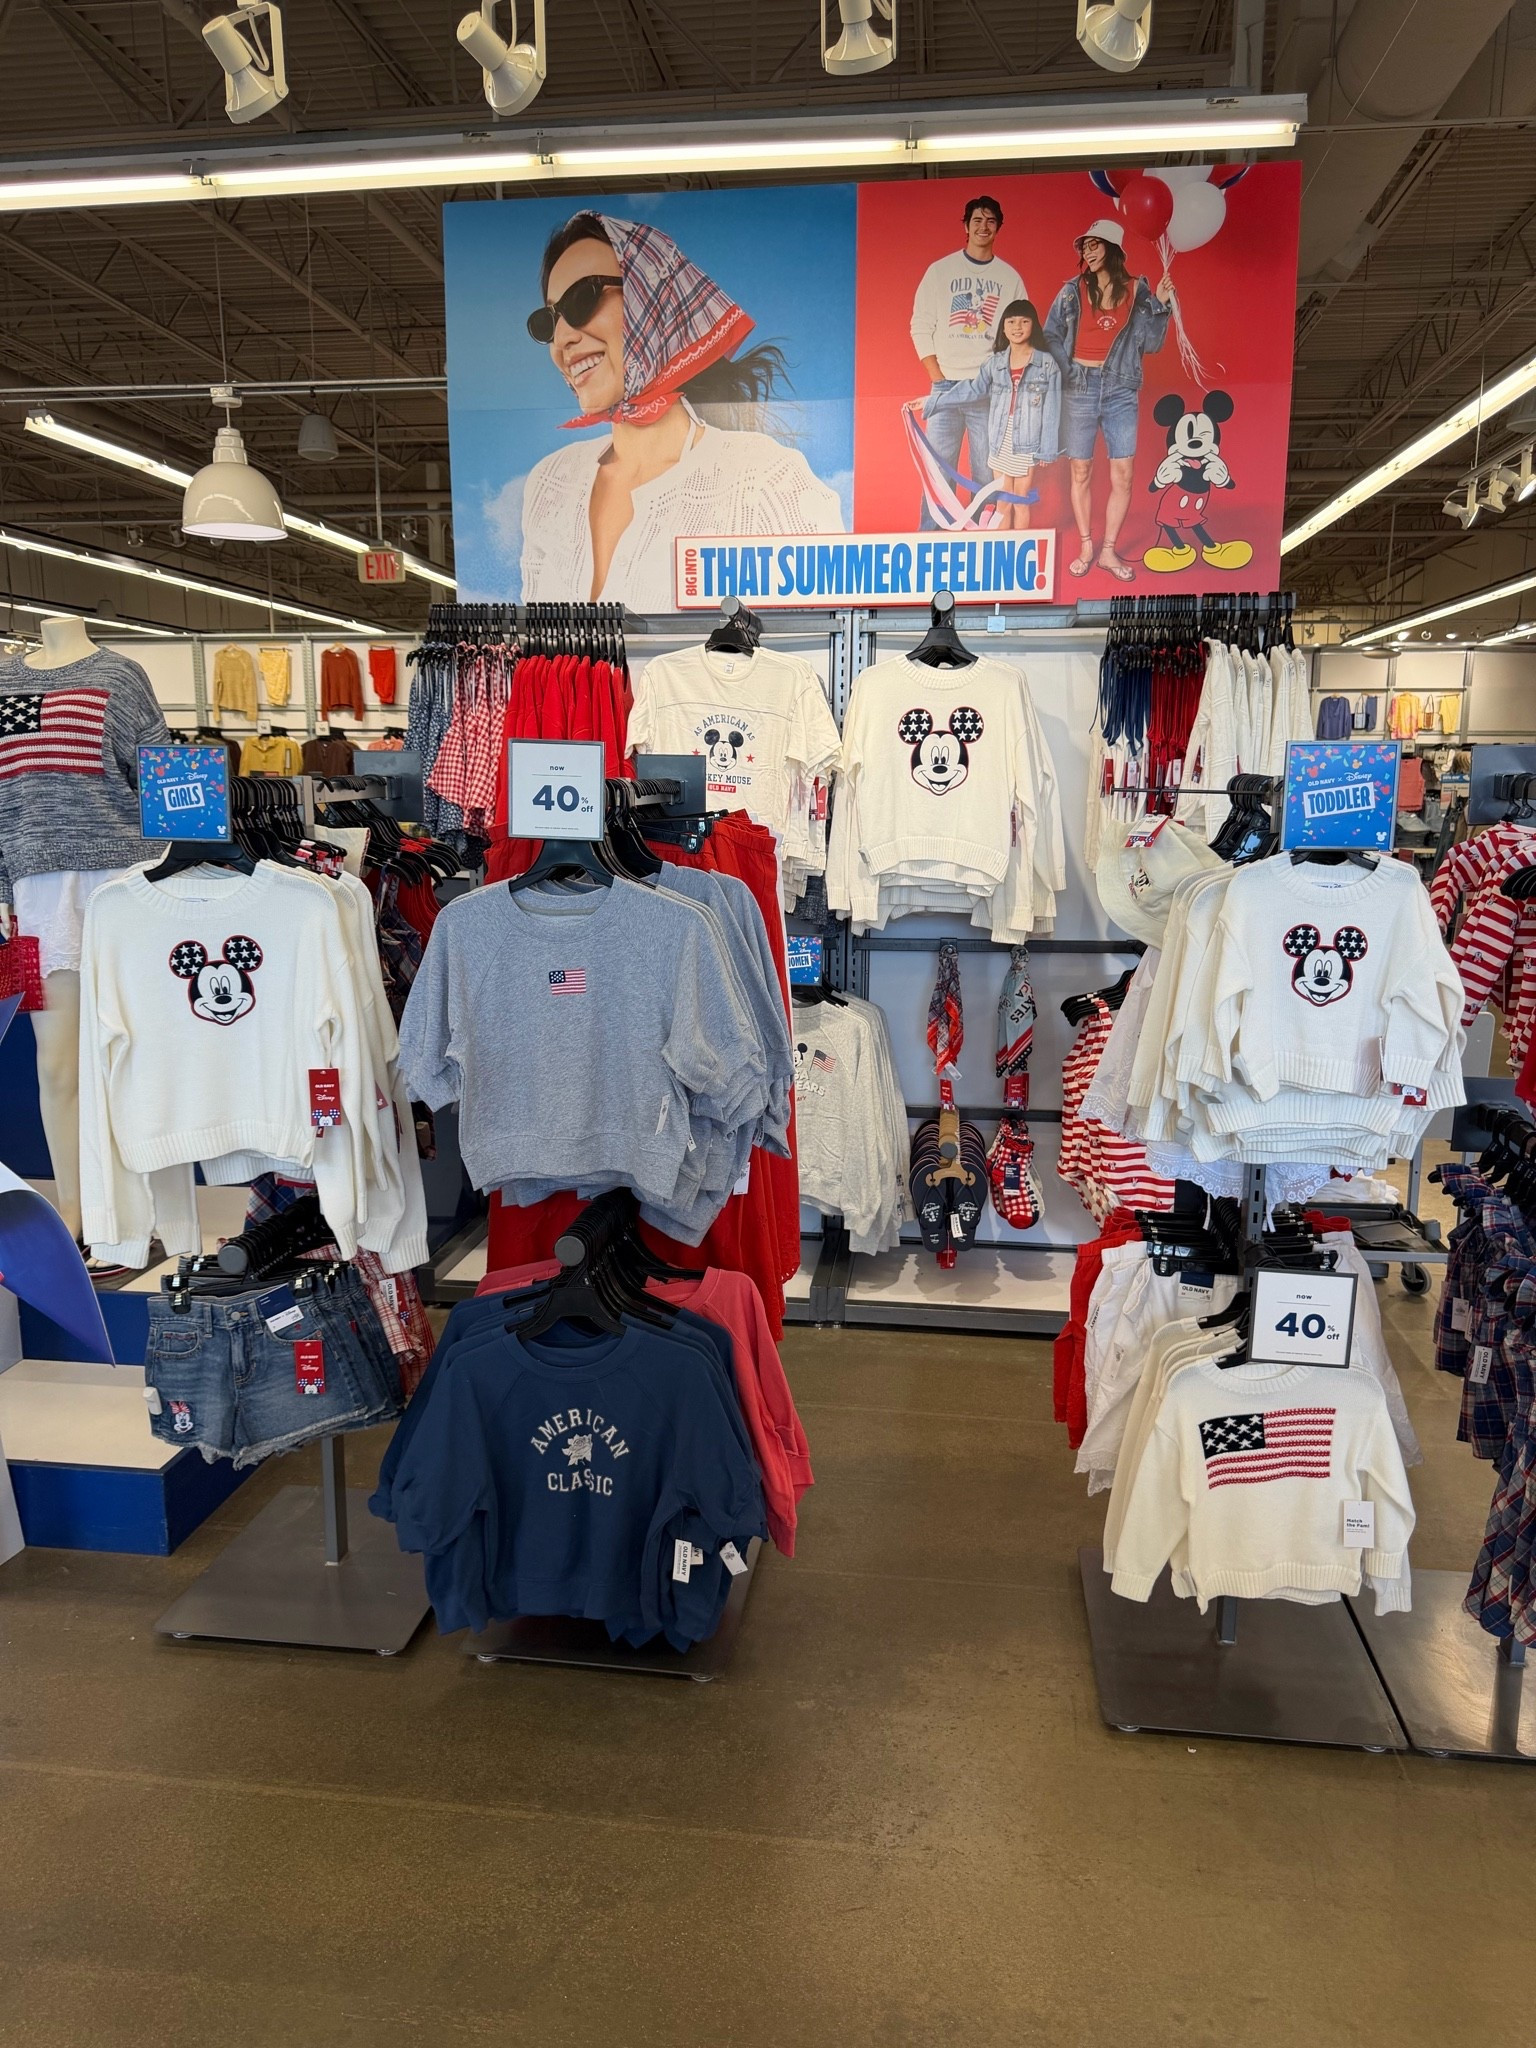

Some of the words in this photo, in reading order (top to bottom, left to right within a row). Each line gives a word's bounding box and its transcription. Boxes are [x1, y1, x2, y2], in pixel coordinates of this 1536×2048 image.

[950, 278, 972, 293] OLD
[976, 278, 1003, 296] NAVY
[365, 553, 396, 579] EXIT
[684, 548, 697, 576] INTO
[700, 546, 774, 597] THAT
[777, 542, 913, 597] SUMMER
[916, 539, 1049, 593] FEELING!
[685, 577, 698, 597] BIG
[694, 726, 703, 737] AS
[702, 714, 749, 732] AMERICAN
[184, 772, 208, 781] Disney
[706, 773, 724, 782] KEY
[725, 774, 752, 785] MOUSE
[1343, 772, 1372, 781] Disney
[167, 785, 201, 808] GIRLS
[532, 784, 580, 812] 40
[1308, 785, 1371, 815] TODDLER
[581, 805, 594, 813] off
[315, 1093, 336, 1102] Disney
[1275, 1312, 1326, 1339] 40
[301, 1363, 320, 1372] Disney
[1479, 1364, 1488, 1379] NAVY
[530, 1408, 630, 1460] AMERICAN
[547, 1468, 613, 1496] CLASSIC
